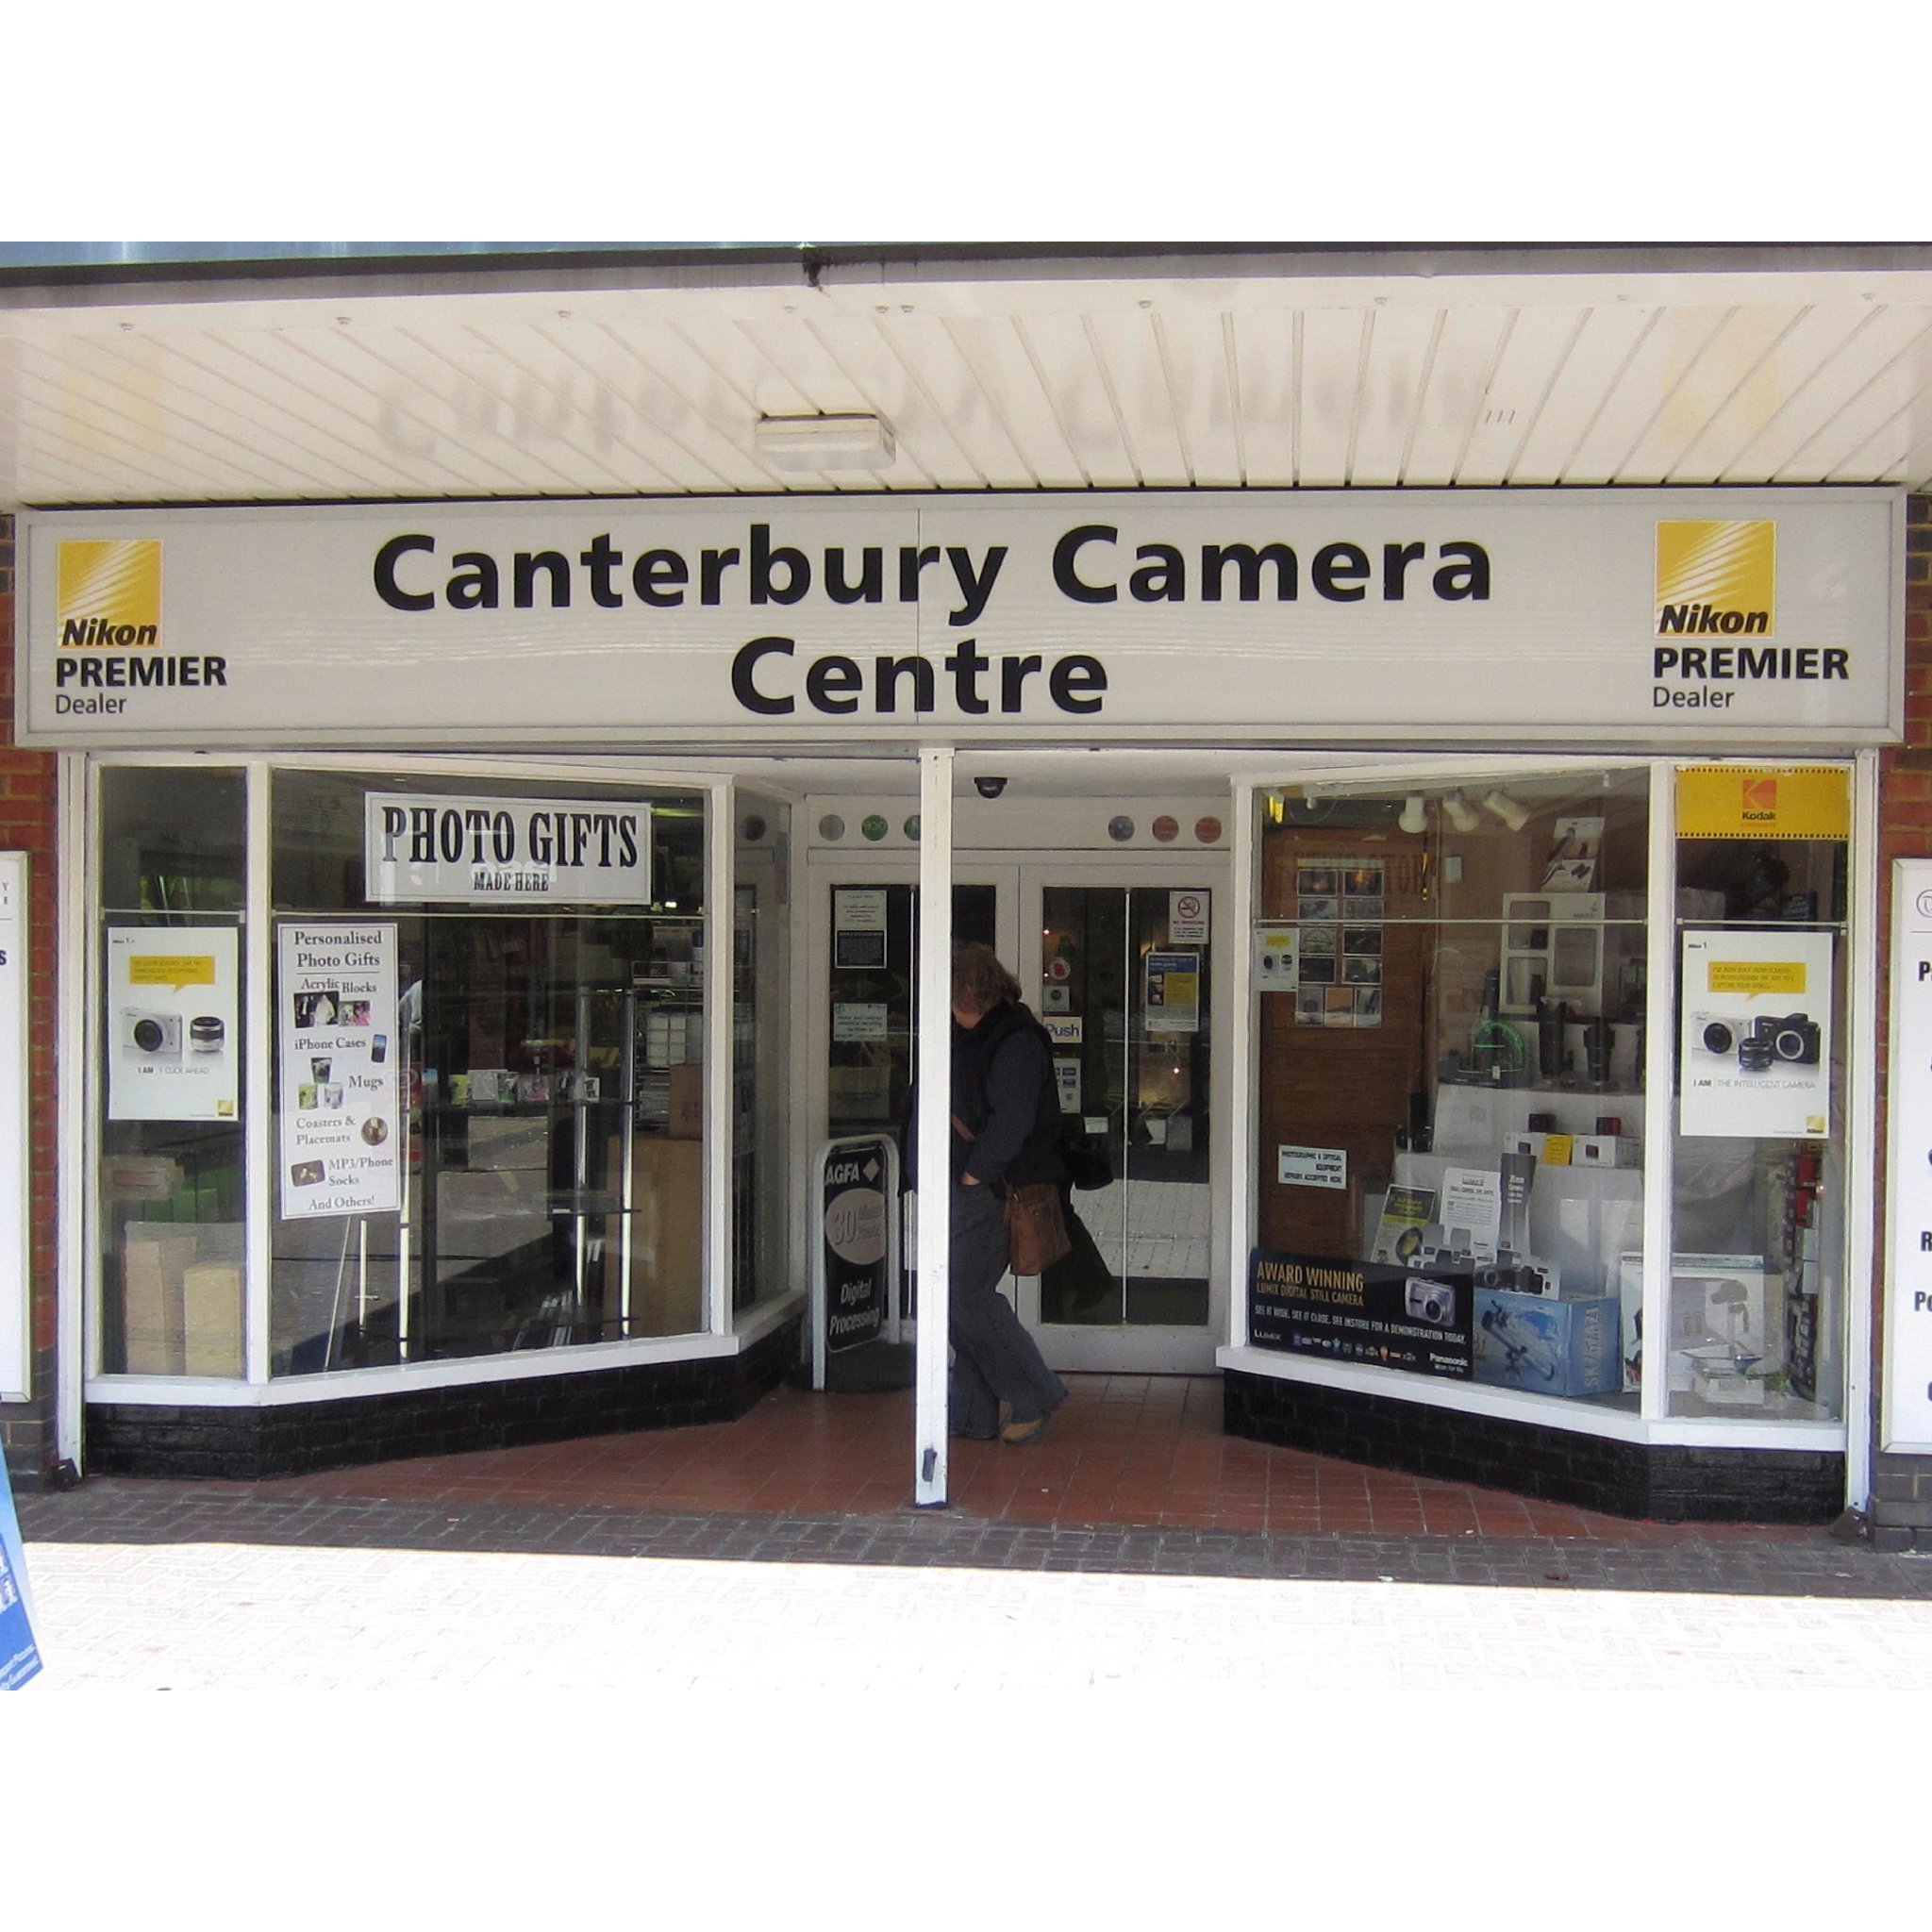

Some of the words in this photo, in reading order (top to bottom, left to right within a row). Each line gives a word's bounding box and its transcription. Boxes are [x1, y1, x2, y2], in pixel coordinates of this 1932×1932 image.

[374, 524, 1008, 626] Canterbury
[1052, 525, 1491, 604] Camera
[1658, 604, 1769, 634] Nikon
[61, 618, 158, 646] Nikon
[57, 657, 226, 687] PREMIER
[1654, 647, 1849, 679] PREMIER
[731, 636, 1108, 715] Centre
[56, 692, 126, 714] Dealer
[1653, 685, 1735, 708] Dealer
[1741, 811, 1775, 821] Kodak
[382, 807, 516, 863] PHOTO
[528, 812, 639, 868] GIFTS
[474, 872, 511, 891] MADE
[514, 872, 549, 891] HERE
[294, 930, 382, 945] Personalised
[297, 953, 341, 967] Photo
[344, 952, 380, 966] Gifts
[301, 978, 340, 992] Acrylic
[341, 982, 377, 993] Blocks
[1046, 1024, 1079, 1037] Push
[294, 1038, 333, 1050] iPhone
[336, 1037, 366, 1048] Cases
[349, 1075, 384, 1091] Mugs
[1717, 1079, 1731, 1088] THE
[296, 1117, 342, 1129] Coasters
[345, 1115, 357, 1126] &
[296, 1135, 351, 1145] Placemats
[328, 1157, 394, 1170] MP3/Phone
[328, 1174, 360, 1186] Socks
[825, 1162, 859, 1186] AGFA
[308, 1197, 332, 1210] And
[334, 1194, 375, 1208] Others!
[1257, 1261, 1302, 1284] AWARD
[1306, 1266, 1364, 1292] WINNING
[841, 1277, 873, 1306] Digital
[1257, 1282, 1279, 1295] LUMIX
[1280, 1284, 1307, 1300] DIGITAL
[1310, 1288, 1330, 1302] STILL
[1332, 1291, 1364, 1307] CAMERA
[829, 1306, 880, 1336] Processing
[1255, 1305, 1266, 1315] SEE
[1267, 1306, 1273, 1316] IT
[1292, 1309, 1302, 1321] SEE
[1304, 1311, 1309, 1321] IT
[1332, 1315, 1343, 1326] SEE
[1371, 1321, 1383, 1332] FOR
[1384, 1323, 1390, 1333] A
[1391, 1324, 1443, 1341] DEMONSTRATION
[1429, 1352, 1469, 1367] Panasonic
